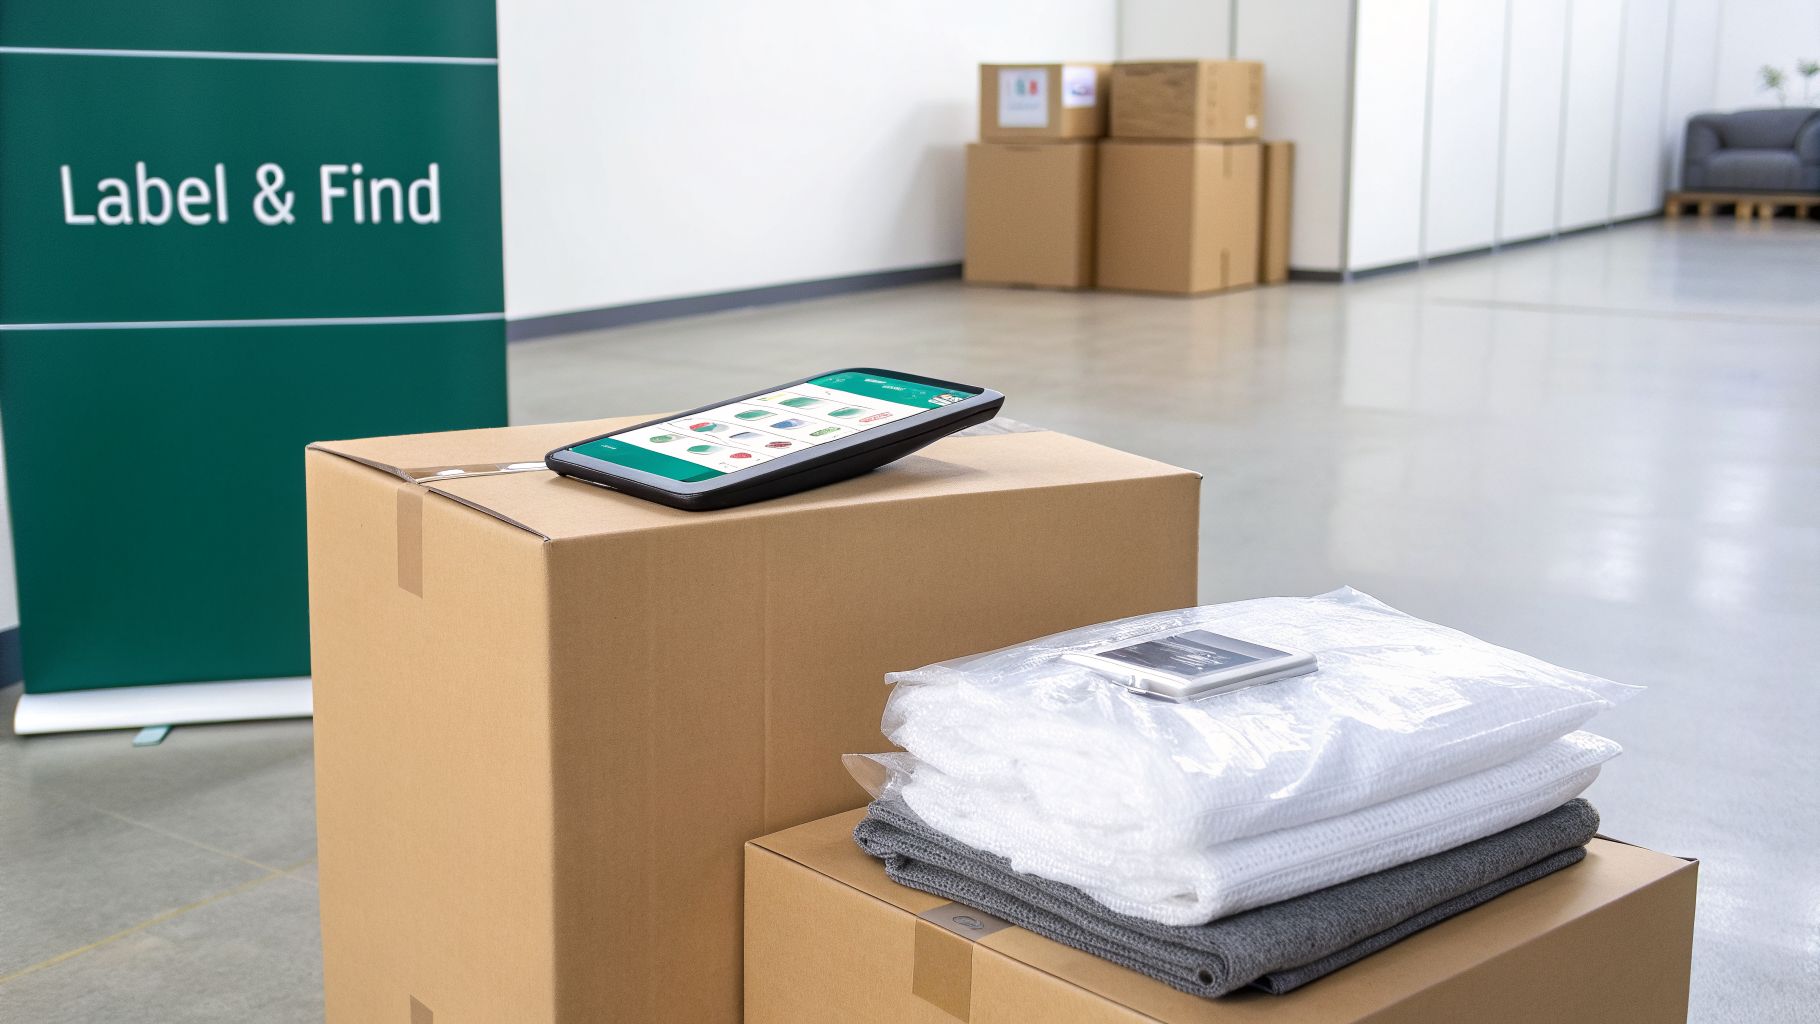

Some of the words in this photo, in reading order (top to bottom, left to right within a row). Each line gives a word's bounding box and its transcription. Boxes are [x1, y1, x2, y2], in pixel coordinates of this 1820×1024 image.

[60, 162, 228, 225] Label
[253, 162, 295, 225] &
[319, 162, 441, 225] Find
